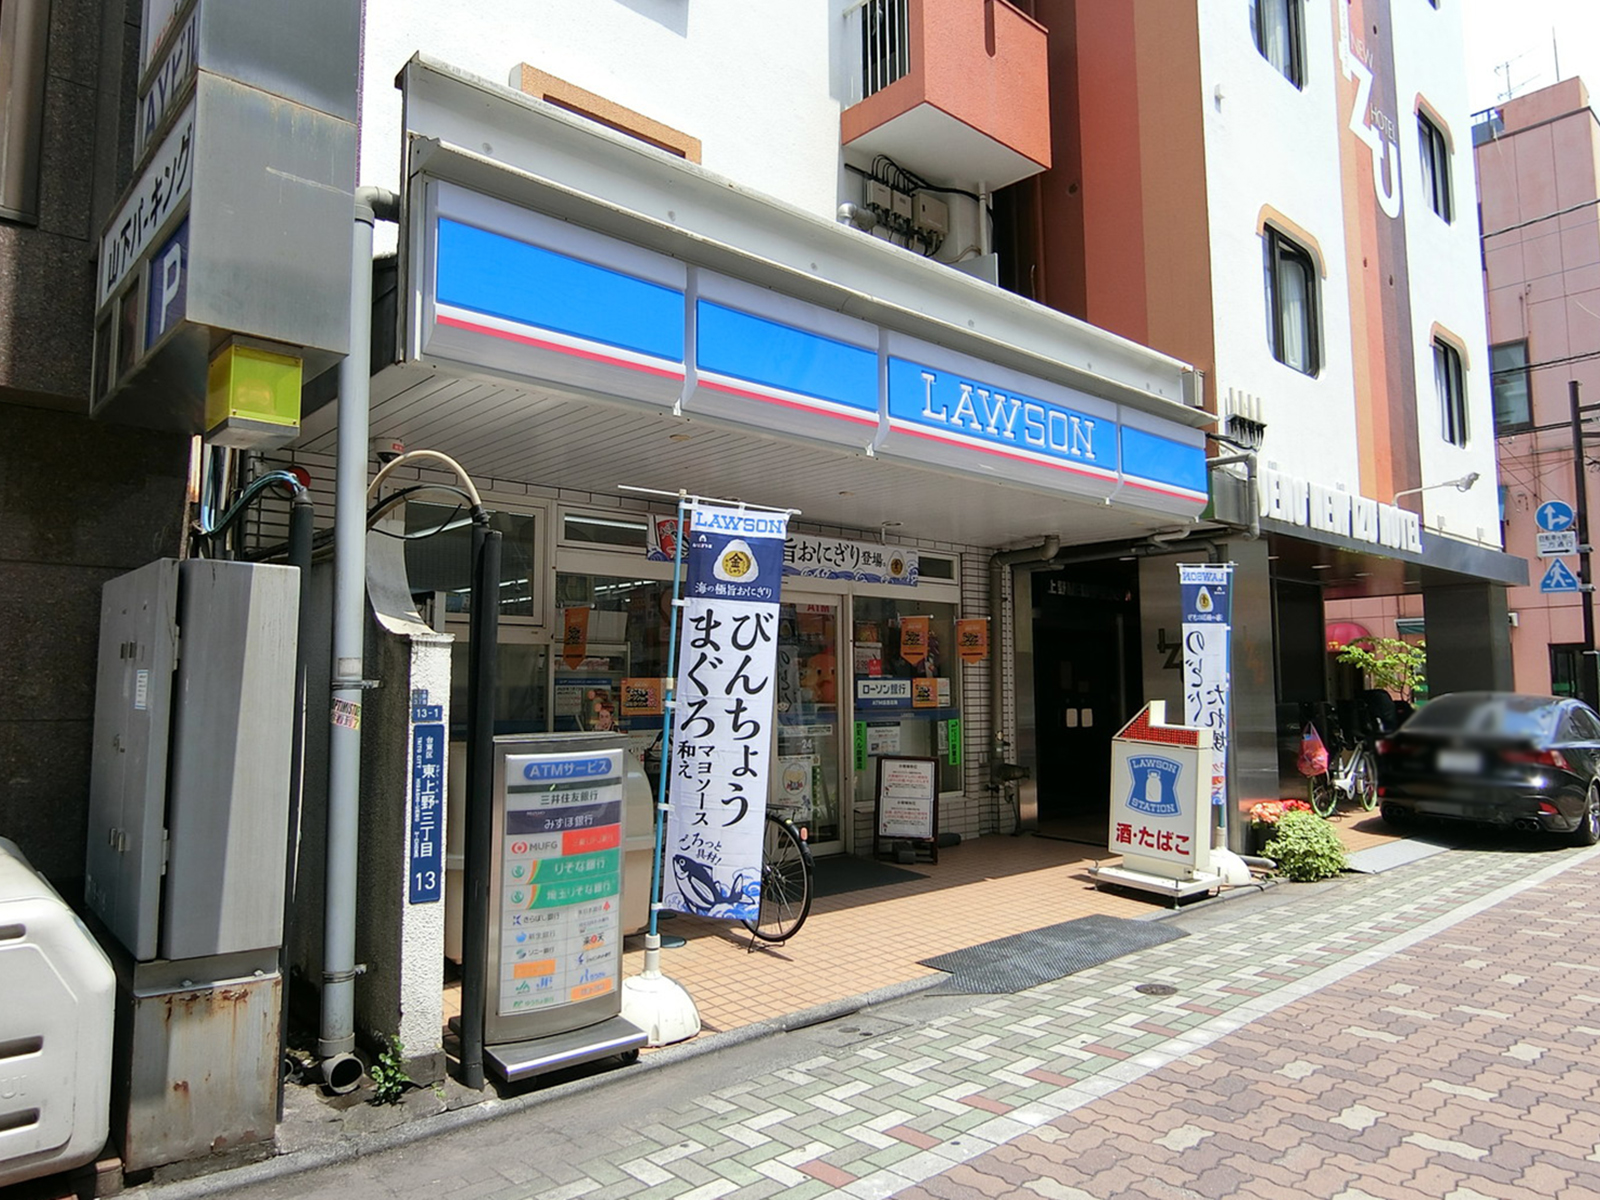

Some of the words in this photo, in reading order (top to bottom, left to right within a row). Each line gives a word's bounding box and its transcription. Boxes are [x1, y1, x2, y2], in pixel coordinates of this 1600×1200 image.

[1350, 31, 1374, 68] NEW
[1369, 102, 1397, 143] HOTEL
[106, 122, 192, 293] 山下パーキング
[159, 242, 182, 335] P
[921, 372, 1096, 460] LAWSON
[695, 512, 784, 535] LAWSON
[694, 582, 773, 599] 海の極旨おにぎり
[680, 608, 724, 739] まぐろ
[862, 683, 906, 695] ローソン銀行
[416, 707, 439, 718] 13-1
[720, 612, 775, 828] びんちょう
[425, 735, 434, 759] 台東区
[529, 760, 609, 777] ATMサービス
[676, 740, 697, 780] 和え
[1131, 758, 1178, 774] LAWSON
[691, 745, 716, 827] マヨソース
[540, 790, 599, 806] 三井住友銀行
[1131, 797, 1176, 813] STATION
[419, 763, 436, 858] 東上野三丁目
[543, 814, 594, 830] みずほ銀行
[529, 841, 558, 852] MUFG
[1115, 822, 1190, 856] 酒・たばこ
[554, 857, 606, 875] りそな銀行
[415, 870, 436, 892] 13
[546, 881, 611, 901] 埼玉りそな銀行
